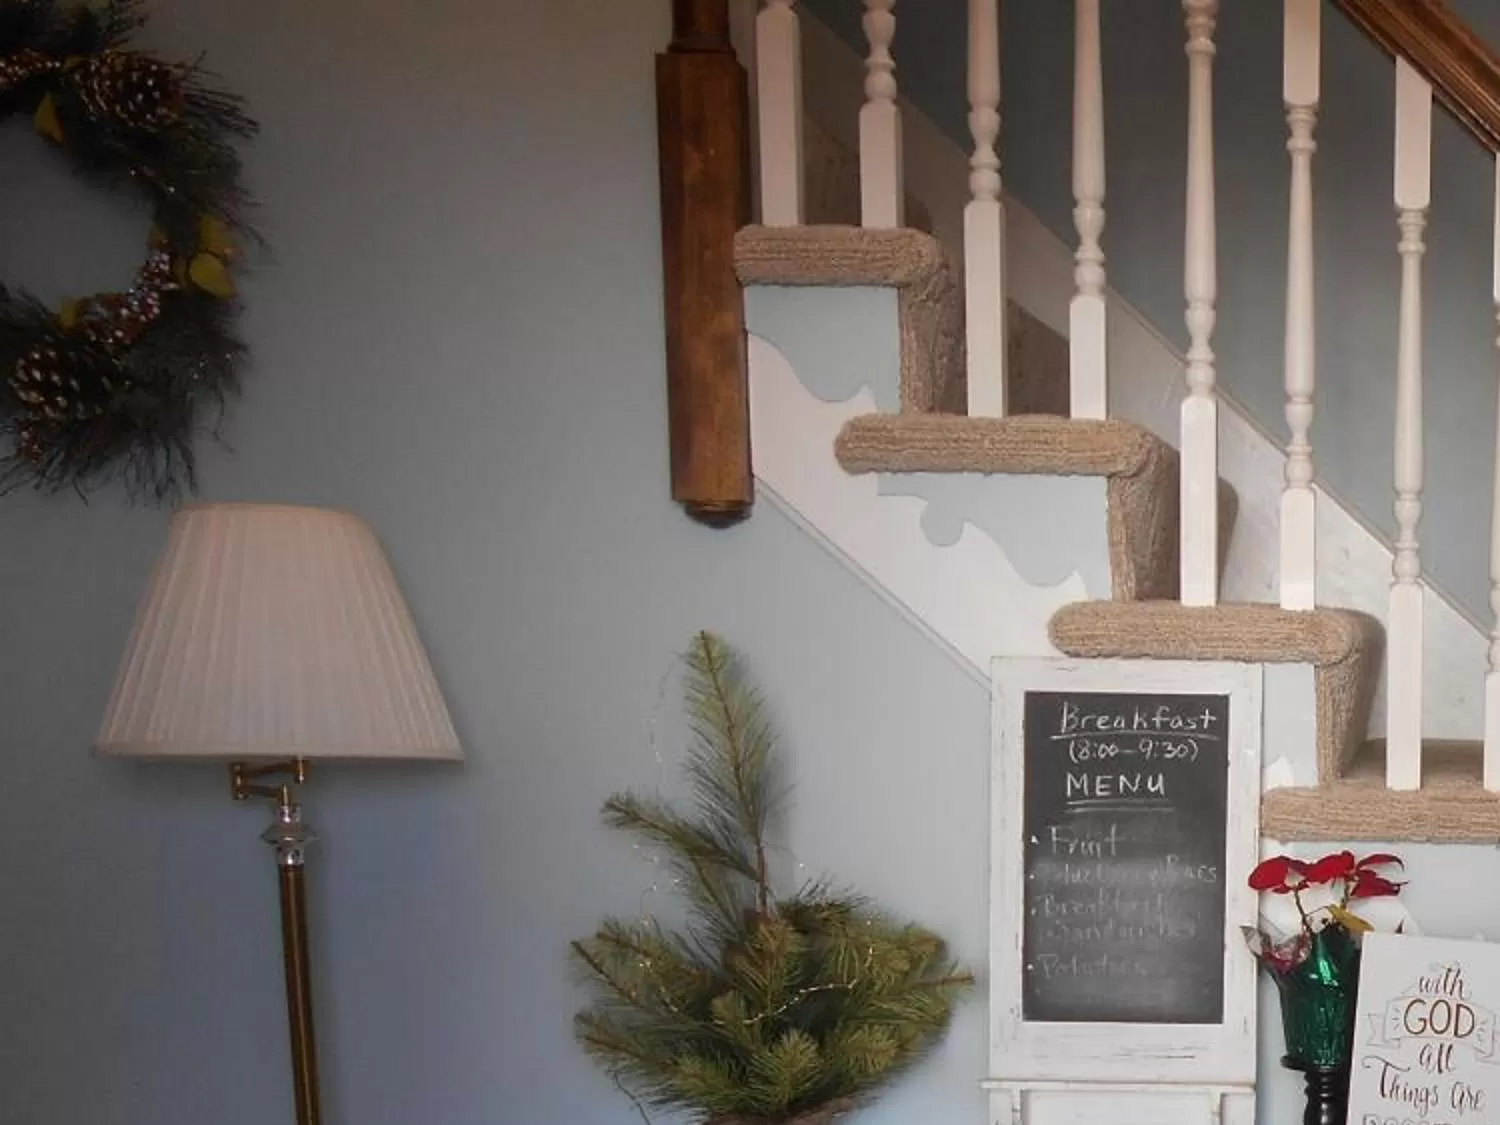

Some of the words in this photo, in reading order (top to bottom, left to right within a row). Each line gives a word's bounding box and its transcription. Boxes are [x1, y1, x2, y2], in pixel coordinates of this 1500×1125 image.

[1061, 701, 1216, 732] Breakfast
[1066, 772, 1165, 798] MENU
[1047, 823, 1126, 857] Fruit
[1418, 964, 1470, 1000] with
[1403, 998, 1476, 1039] GOD
[1419, 1042, 1456, 1075] all
[1362, 1056, 1440, 1117] Things
